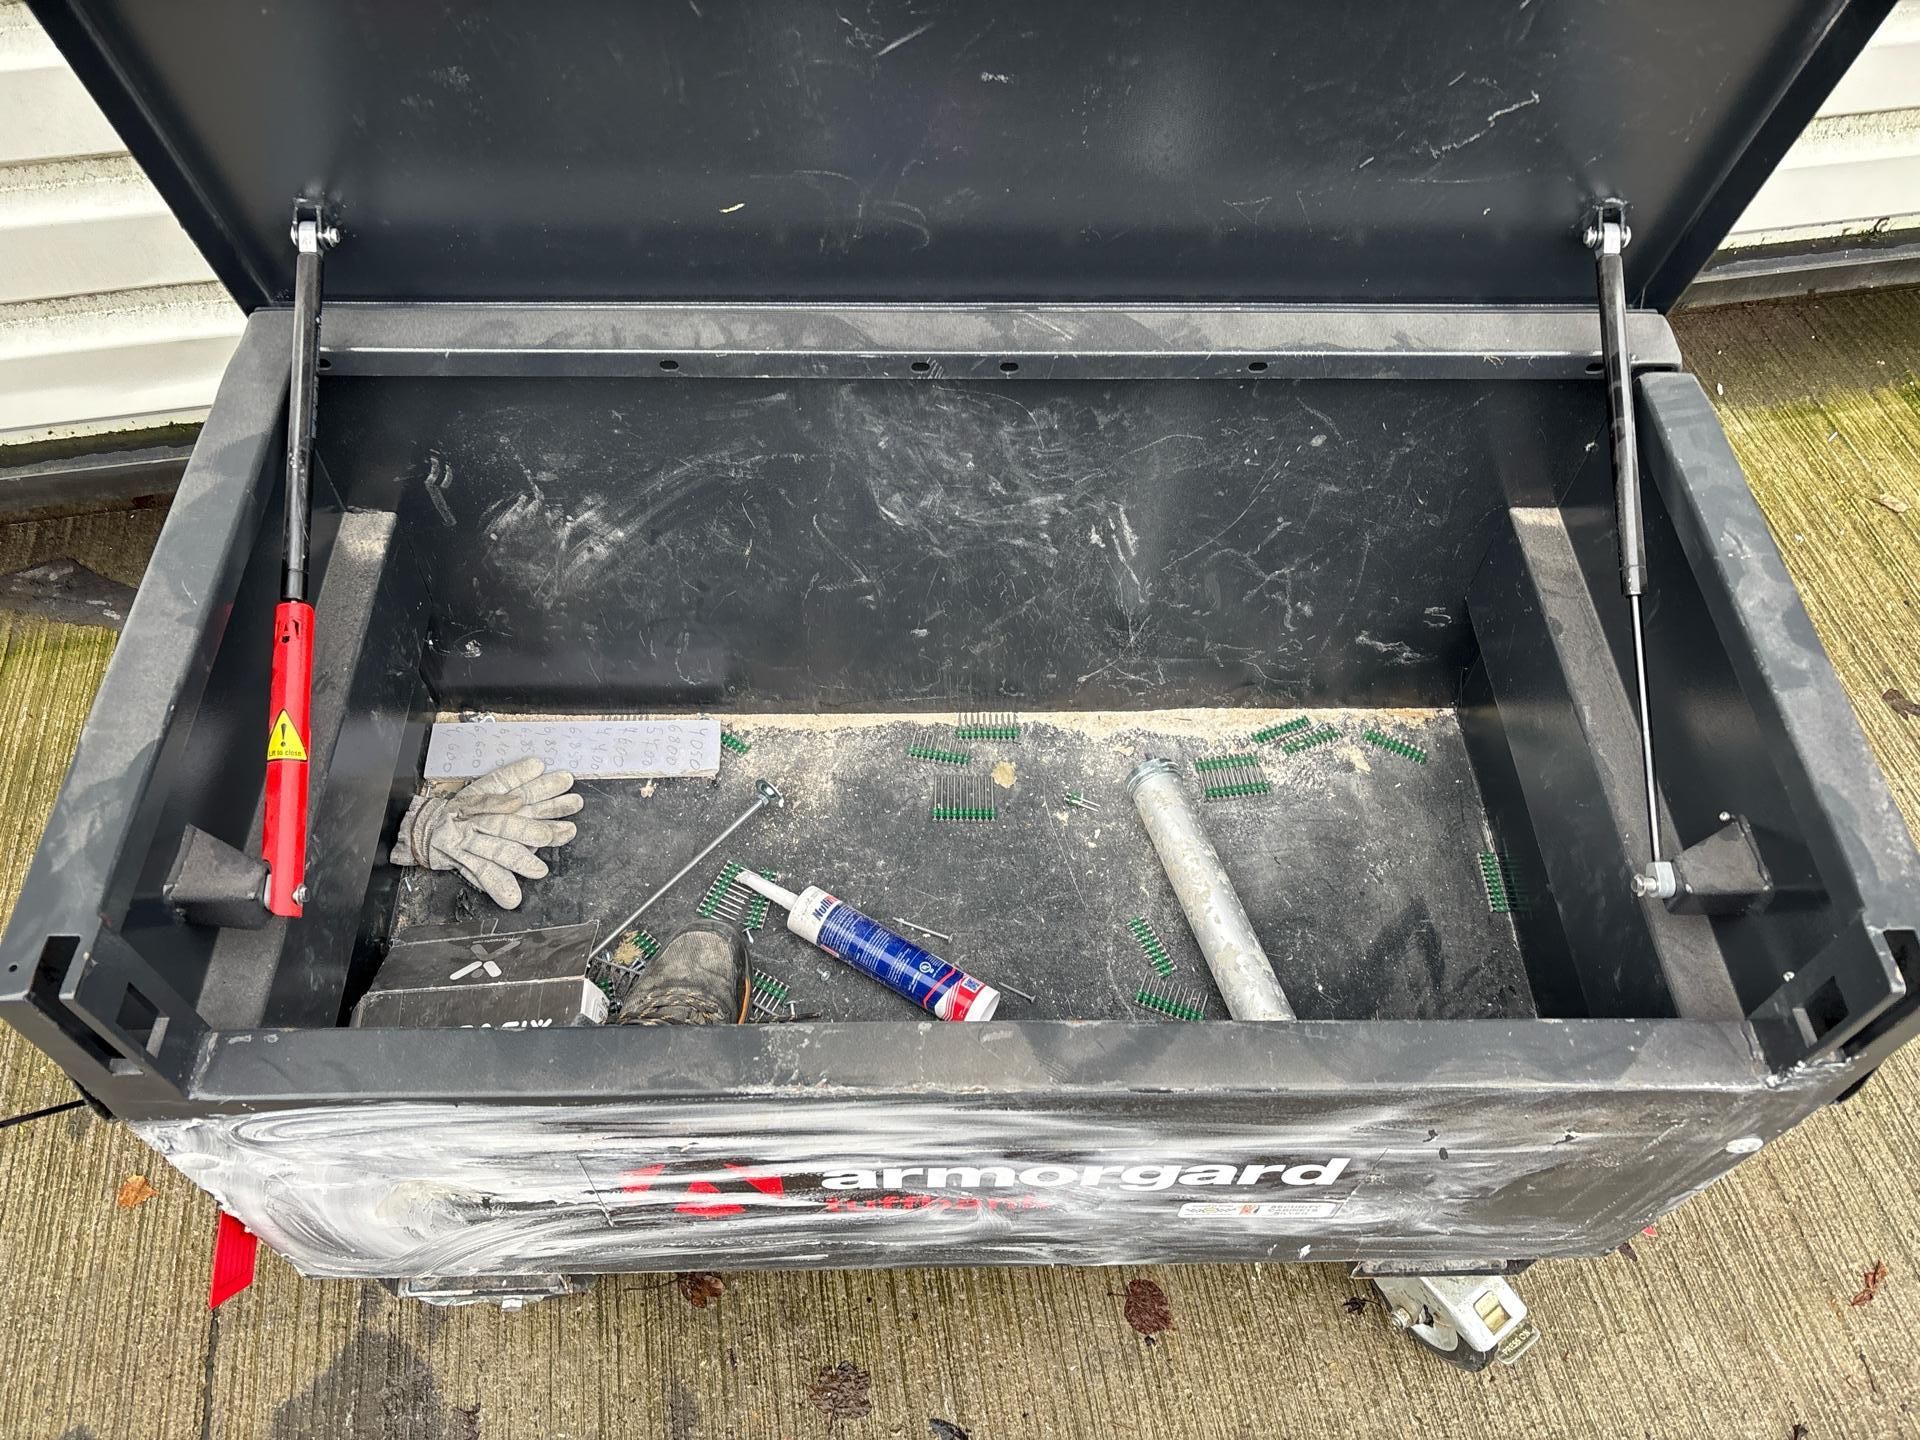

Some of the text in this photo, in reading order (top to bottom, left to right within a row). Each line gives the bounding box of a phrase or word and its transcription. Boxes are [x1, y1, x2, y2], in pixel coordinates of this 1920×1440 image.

[821, 1158, 1351, 1191] armorgard
[1502, 1329, 1530, 1355] PRESS ON
